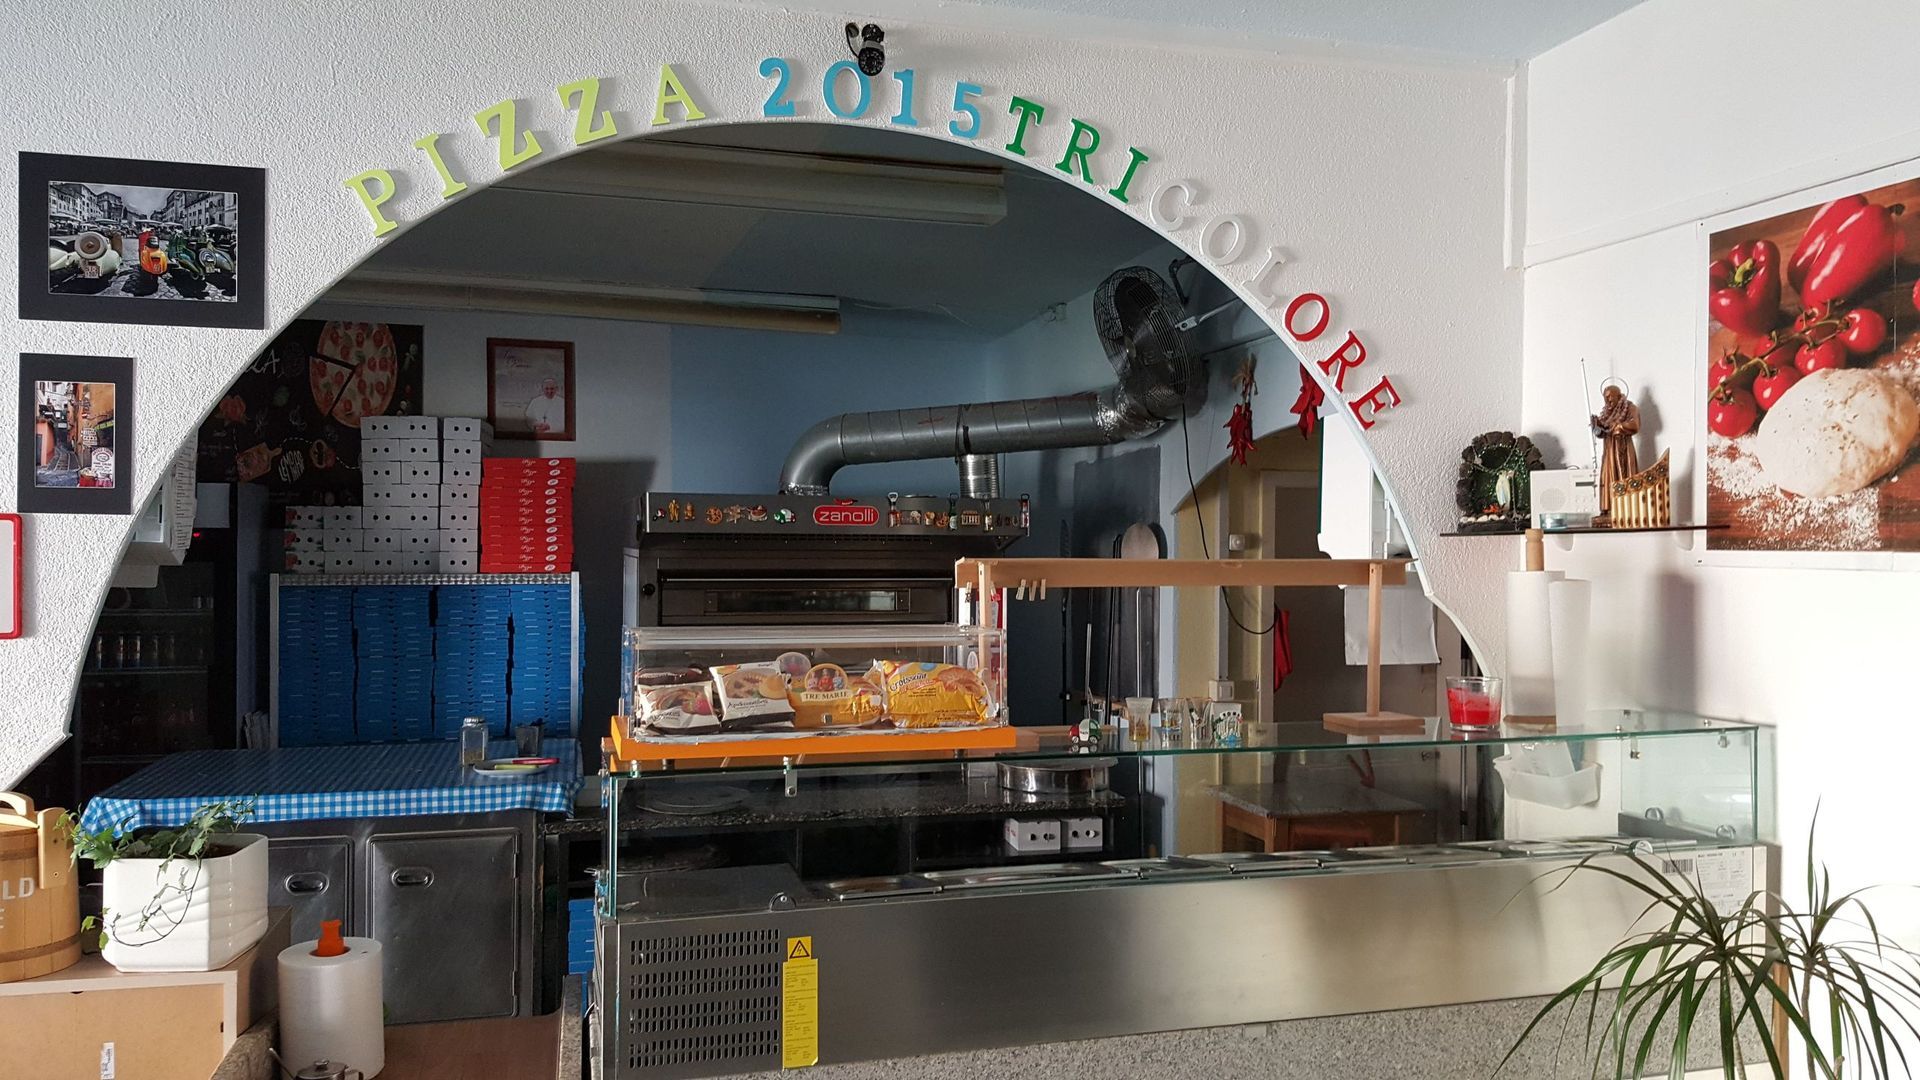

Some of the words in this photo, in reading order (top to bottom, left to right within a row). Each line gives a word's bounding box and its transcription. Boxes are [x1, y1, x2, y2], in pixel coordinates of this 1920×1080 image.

[343, 63, 706, 238] PIZZA
[996, 95, 1402, 431] TRICOLORE
[819, 508, 874, 522] zanolli
[804, 692, 821, 701] TRE
[822, 690, 849, 700] MARIE
